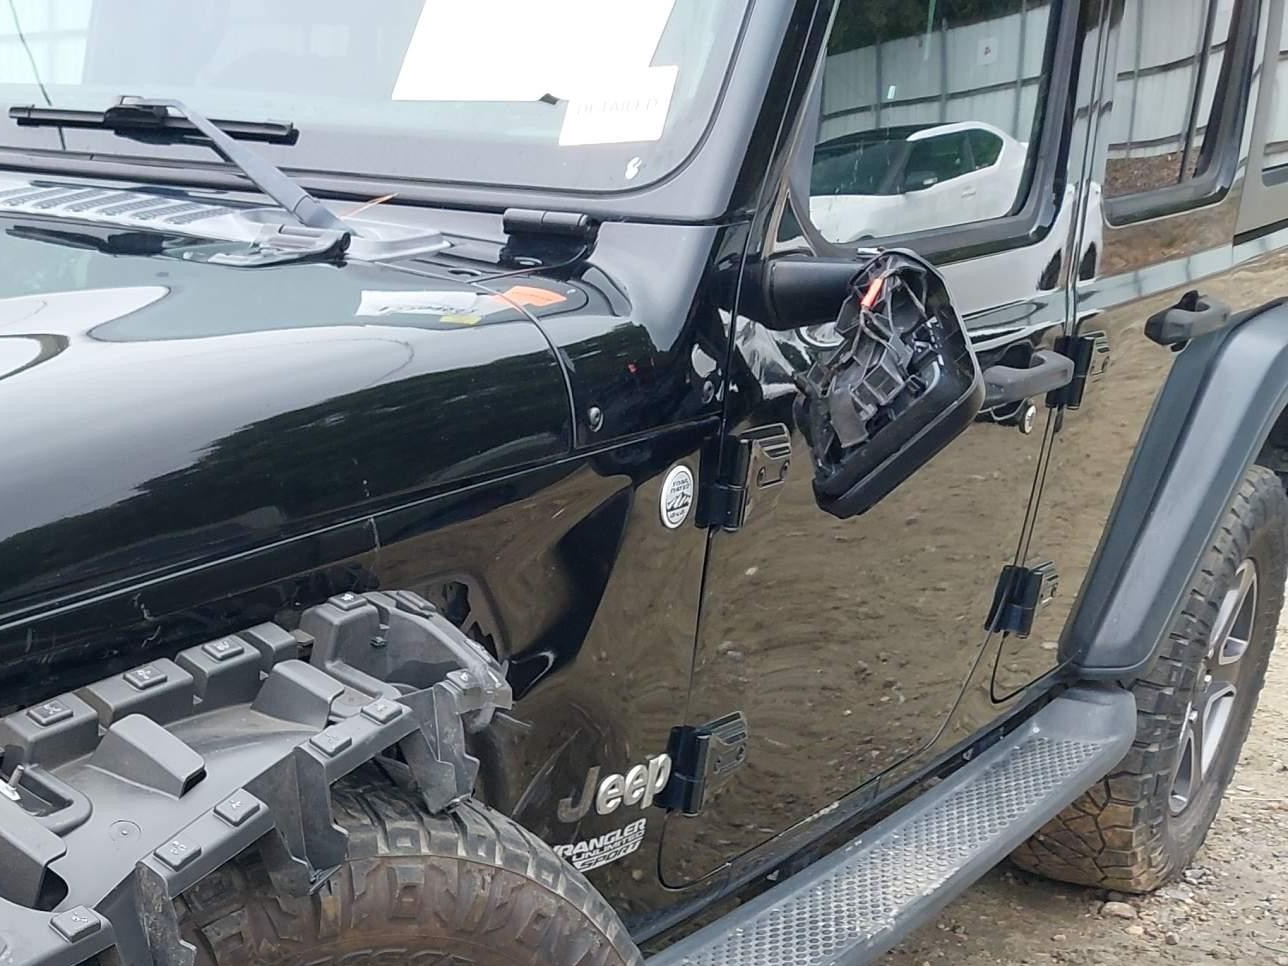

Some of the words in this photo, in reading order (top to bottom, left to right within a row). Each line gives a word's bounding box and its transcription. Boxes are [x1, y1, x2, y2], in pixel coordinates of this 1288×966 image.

[557, 753, 672, 823] Jeep
[553, 818, 647, 858] RANGLER
[572, 830, 646, 861] UNLIMITED
[576, 840, 643, 870] SPORT
